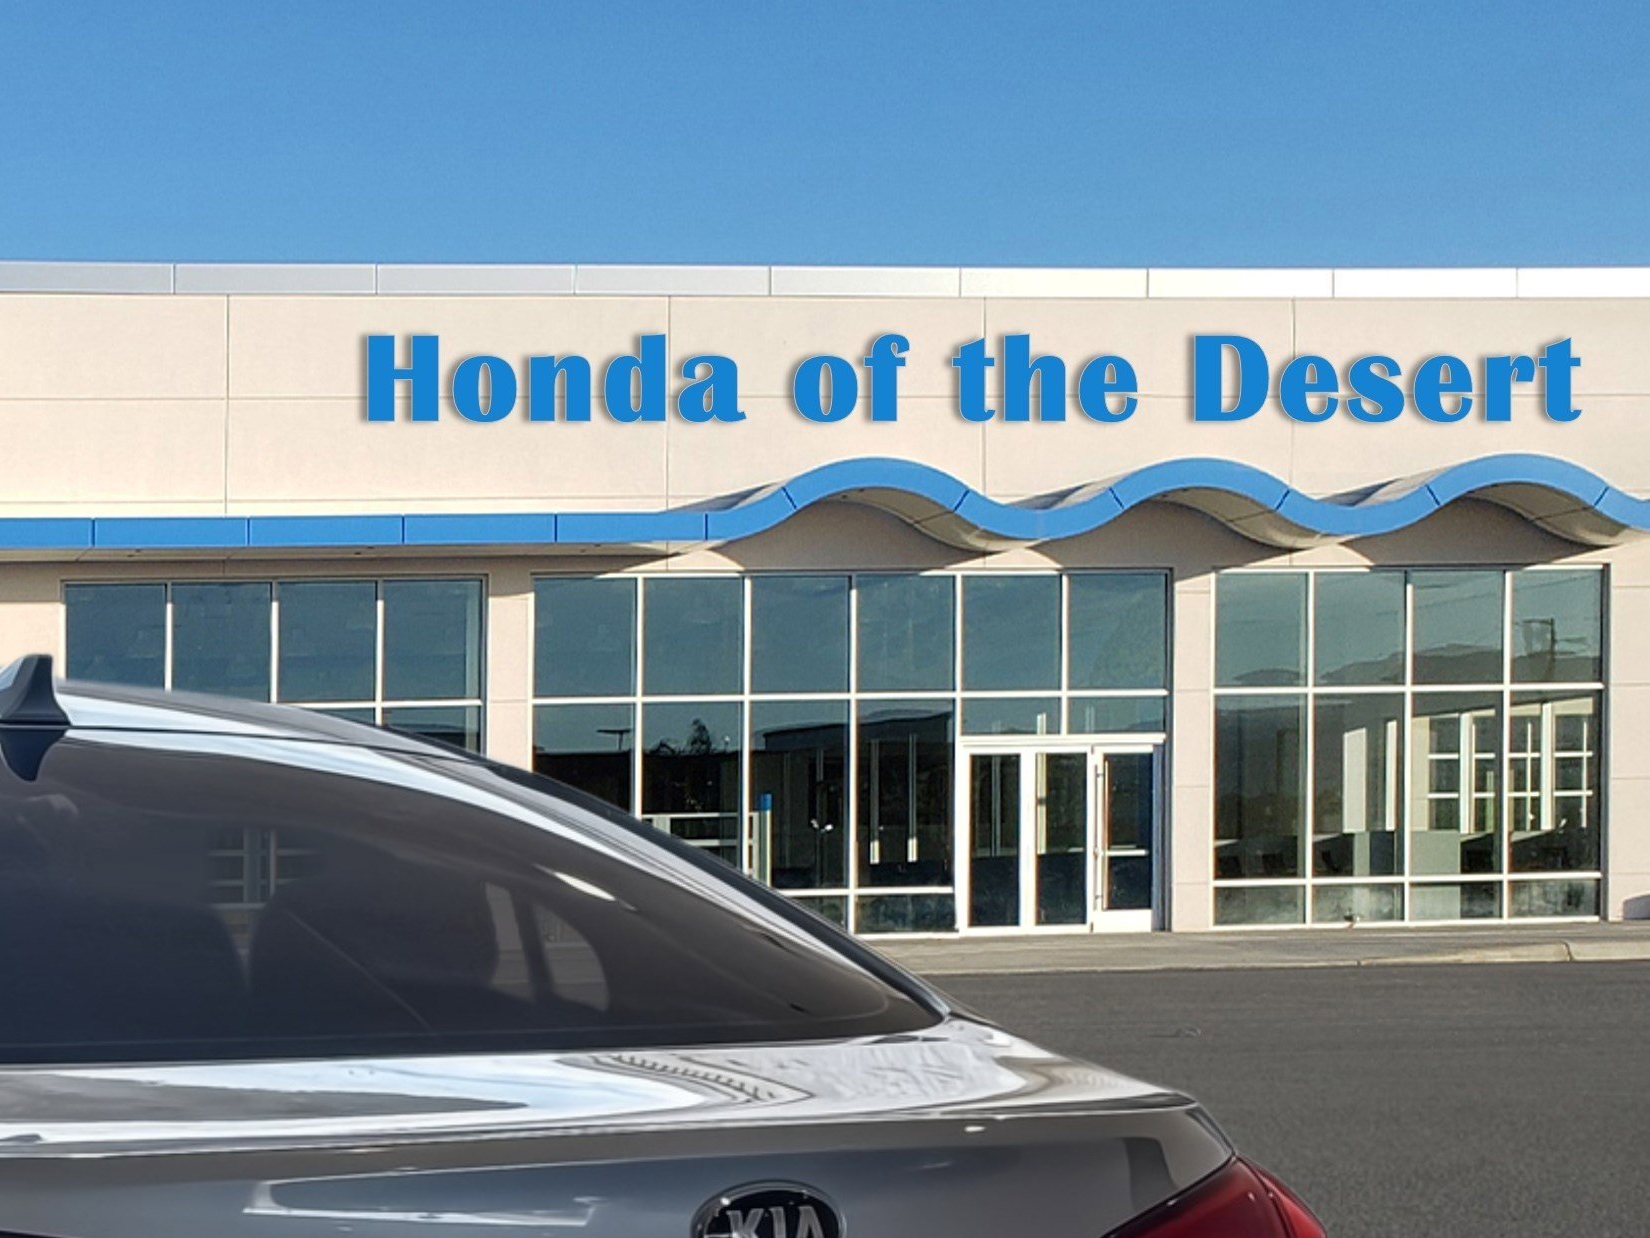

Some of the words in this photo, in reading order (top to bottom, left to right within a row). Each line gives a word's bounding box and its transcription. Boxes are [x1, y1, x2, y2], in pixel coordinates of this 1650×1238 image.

[368, 334, 747, 424] Honda
[793, 333, 910, 423] of
[952, 333, 1138, 423] the
[1193, 334, 1582, 424] Desert
